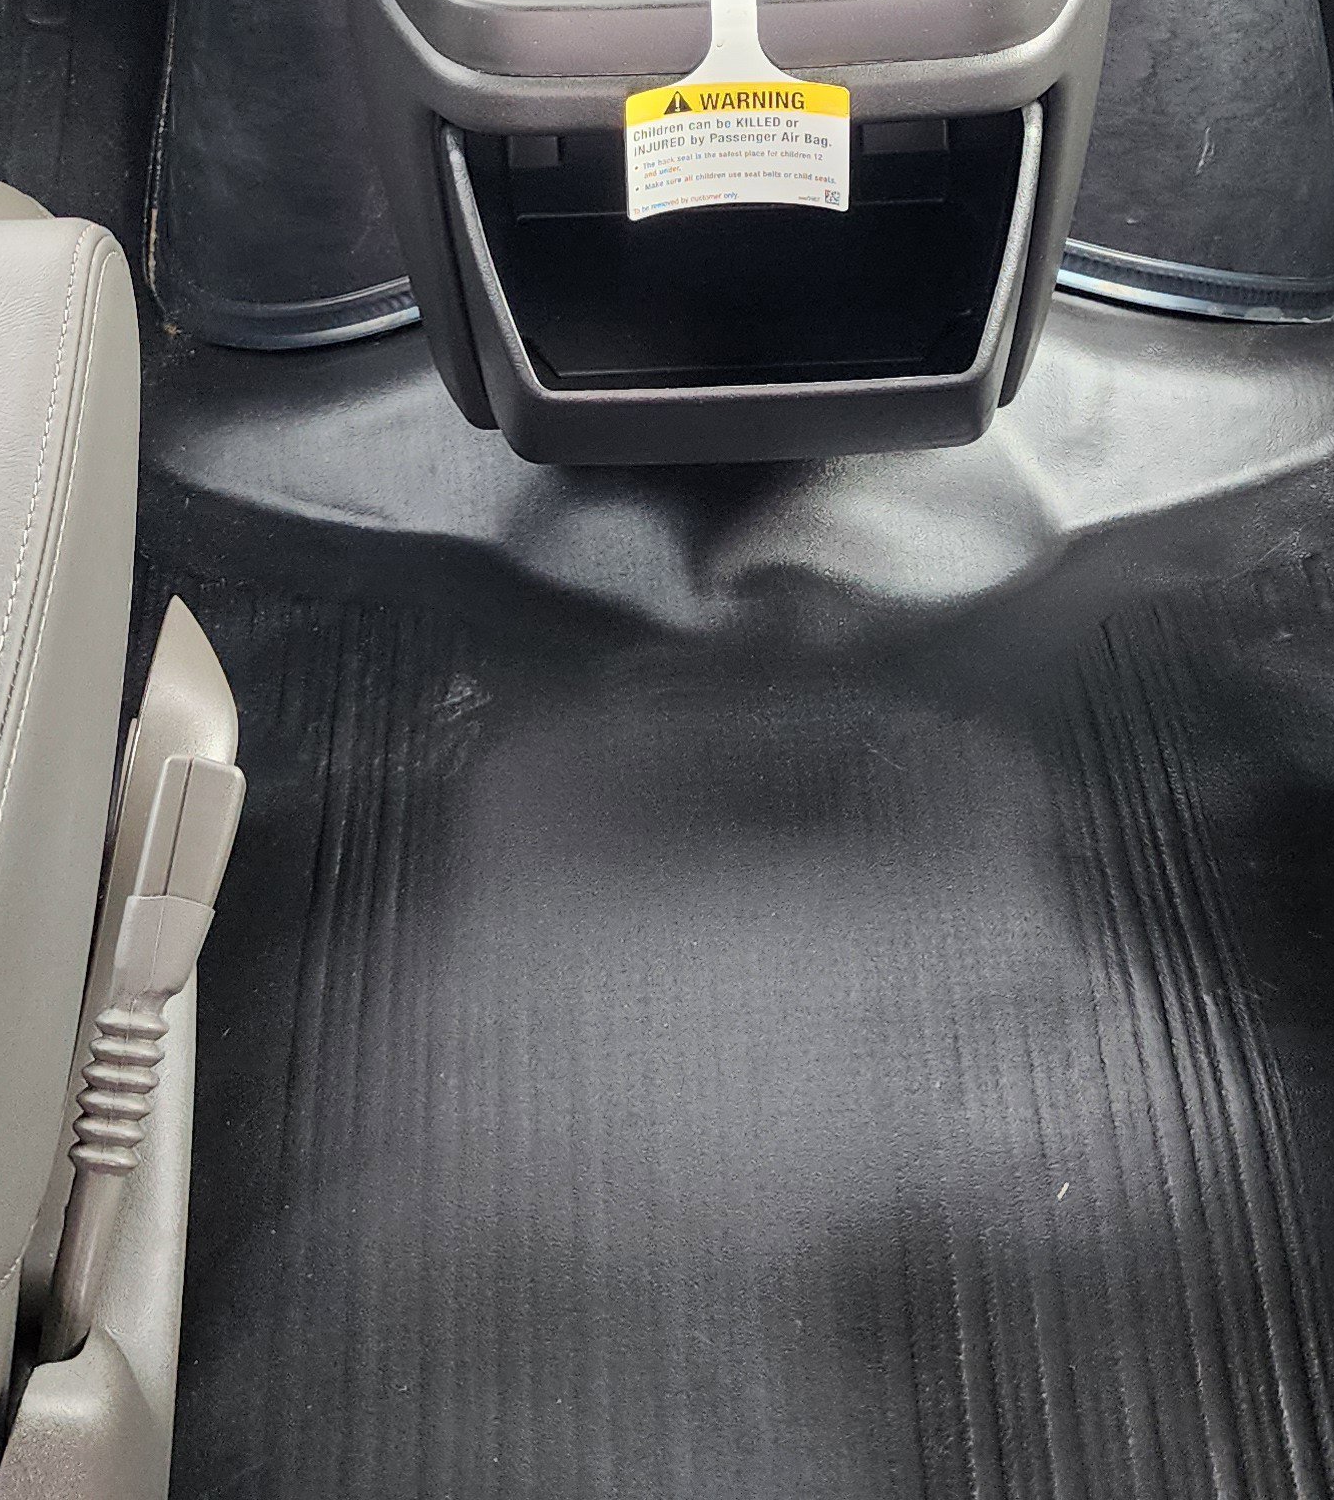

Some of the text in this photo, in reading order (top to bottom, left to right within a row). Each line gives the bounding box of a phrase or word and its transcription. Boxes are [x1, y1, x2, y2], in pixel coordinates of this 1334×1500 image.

[699, 90, 805, 110] WARNING
[633, 116, 799, 142] Children can be KILLED or
[634, 132, 832, 157] INJURED by Passenger Air Bag.
[744, 150, 765, 158] place
[780, 150, 811, 160] children
[814, 153, 823, 161] 12
[645, 180, 664, 191] Make
[684, 174, 693, 182] all
[695, 172, 726, 181] children
[793, 172, 813, 180] child
